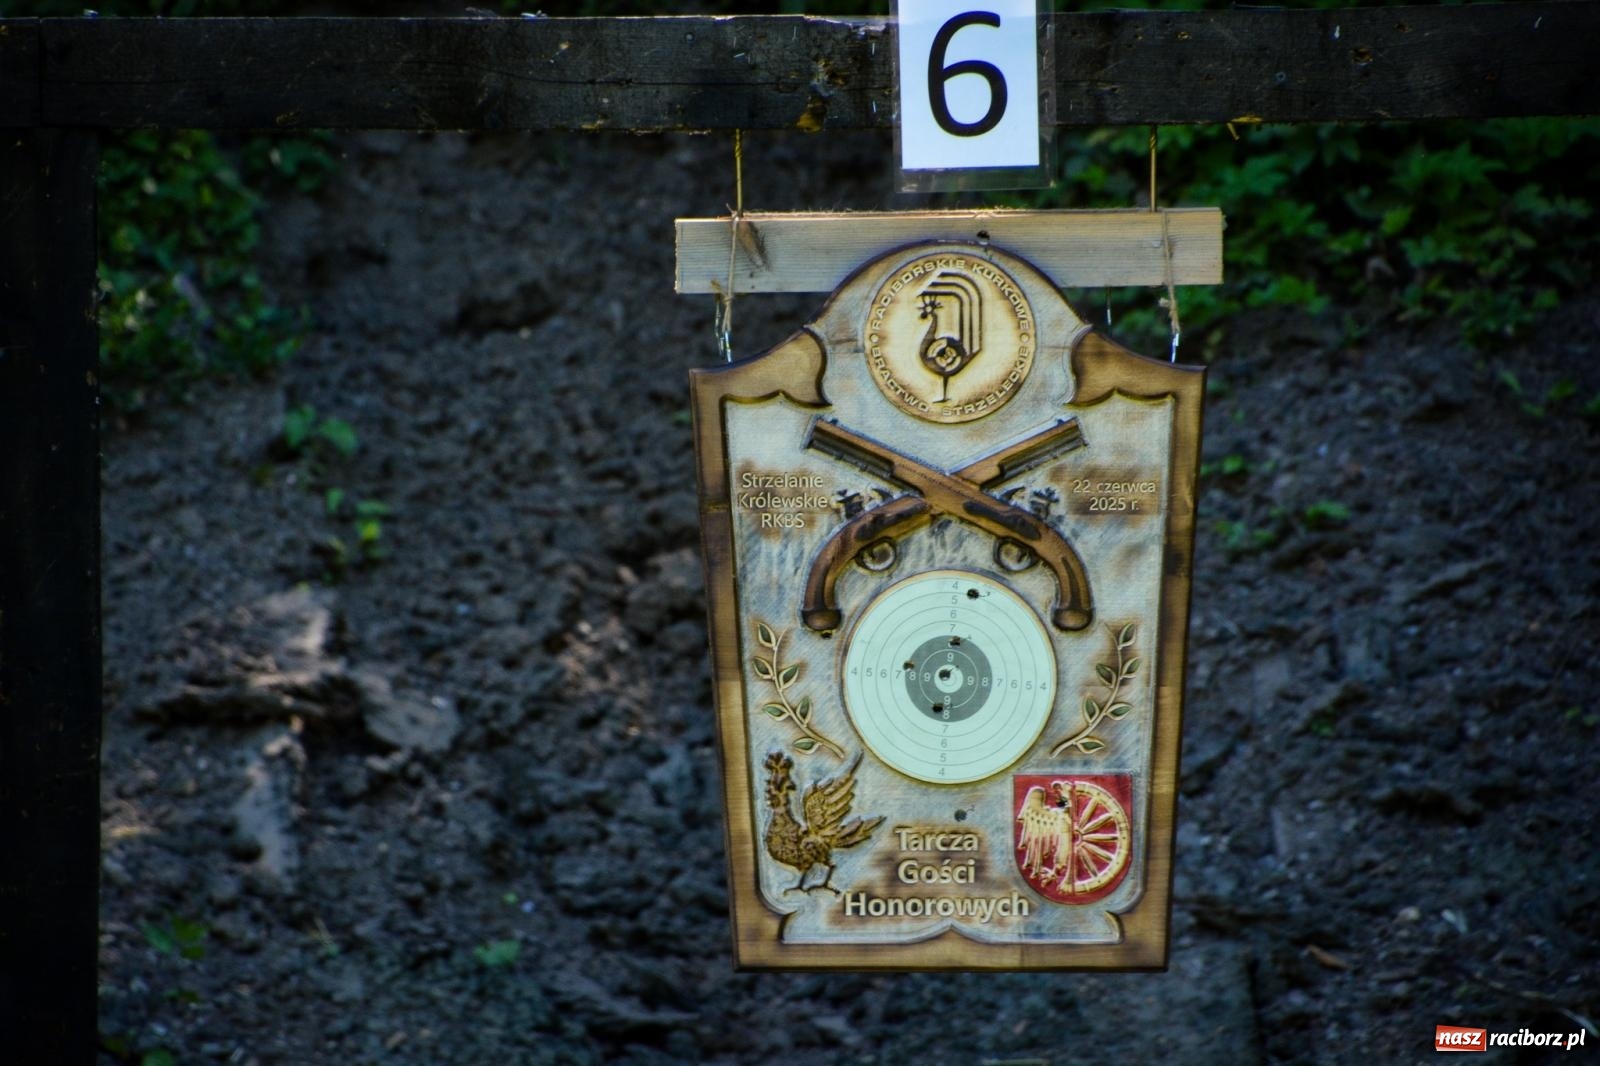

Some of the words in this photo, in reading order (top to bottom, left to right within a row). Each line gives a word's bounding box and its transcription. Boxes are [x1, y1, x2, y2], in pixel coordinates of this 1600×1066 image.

[928, 10, 1008, 137] 6
[871, 259, 966, 332] RACIBORSKIE
[972, 264, 1030, 331] KURKOWE
[871, 346, 931, 414] BRACTWO
[941, 346, 1029, 417] STRZELECKIE
[742, 472, 824, 488] Strzelanie
[1073, 479, 1092, 493] 22
[1096, 481, 1157, 493] czerwca
[738, 492, 828, 508] Królewskie
[1089, 497, 1127, 511] 2025
[1131, 499, 1140, 511] r.
[761, 512, 806, 528] RKBS
[951, 581, 960, 590] 4
[951, 595, 959, 605] 5
[949, 623, 957, 633] 7
[946, 652, 955, 662] 9
[895, 670, 902, 679] 7
[909, 671, 917, 681] 8
[981, 677, 989, 687] 8
[996, 678, 1003, 687] 7
[1025, 680, 1033, 690] 5
[1039, 681, 1047, 690] 4
[942, 709, 951, 720] 8
[896, 827, 979, 852] Tarcza
[898, 858, 976, 885] Gości
[844, 891, 1029, 924] Honorowych
